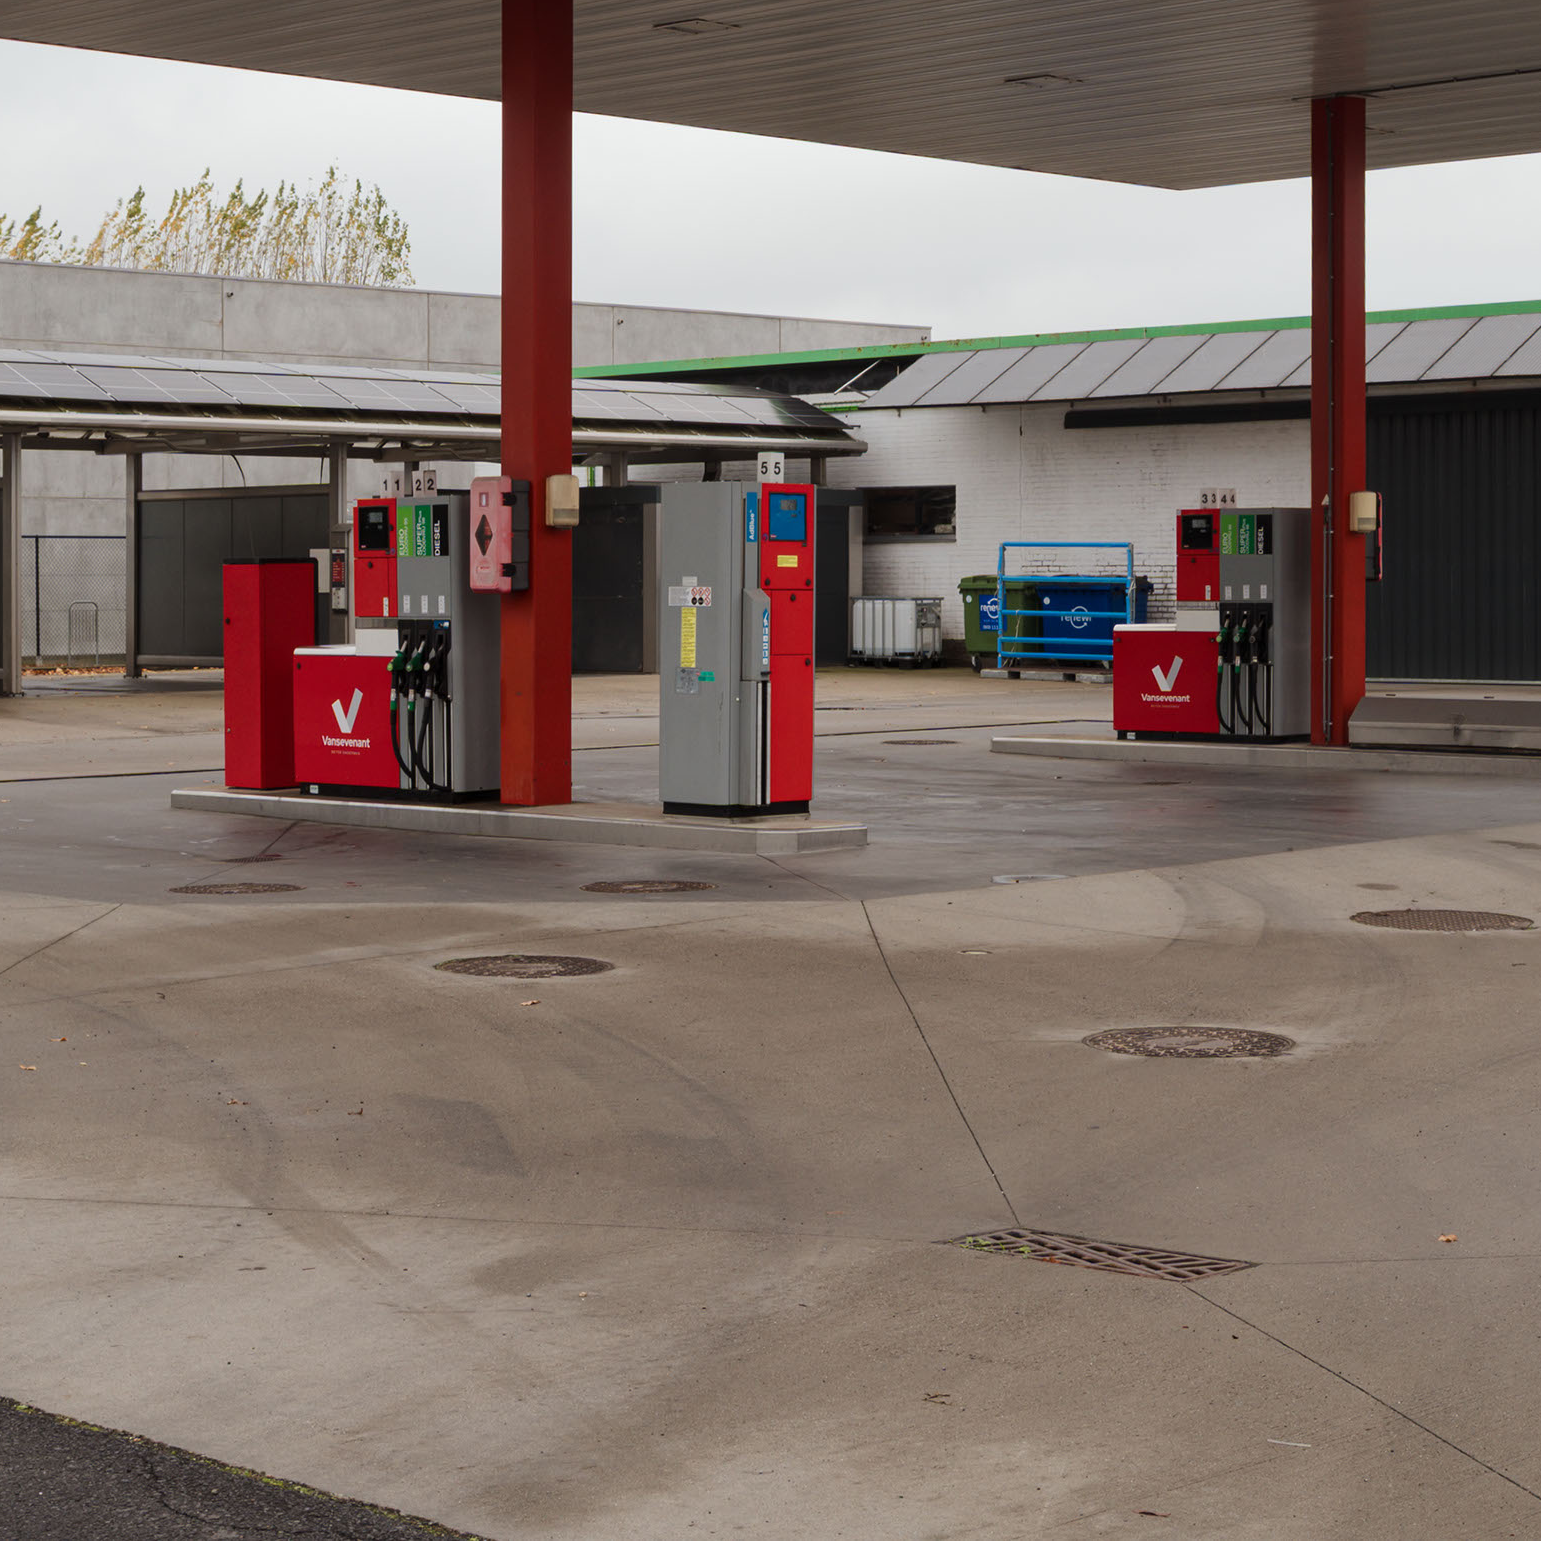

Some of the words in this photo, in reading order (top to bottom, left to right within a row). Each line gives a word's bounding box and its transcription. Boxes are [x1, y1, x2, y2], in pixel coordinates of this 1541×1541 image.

[760, 461, 768, 475] 5
[774, 462, 781, 475] 5
[383, 479, 388, 491] 1
[395, 479, 400, 491] 1
[415, 479, 422, 491] 2
[427, 479, 435, 491] 2
[1201, 493, 1208, 504] 3
[1211, 493, 1217, 504] 3
[1221, 494, 1227, 504] 4
[1230, 494, 1236, 504] 4
[1140, 693, 1191, 703] Vansevenant
[322, 735, 370, 748] Vansevenant
